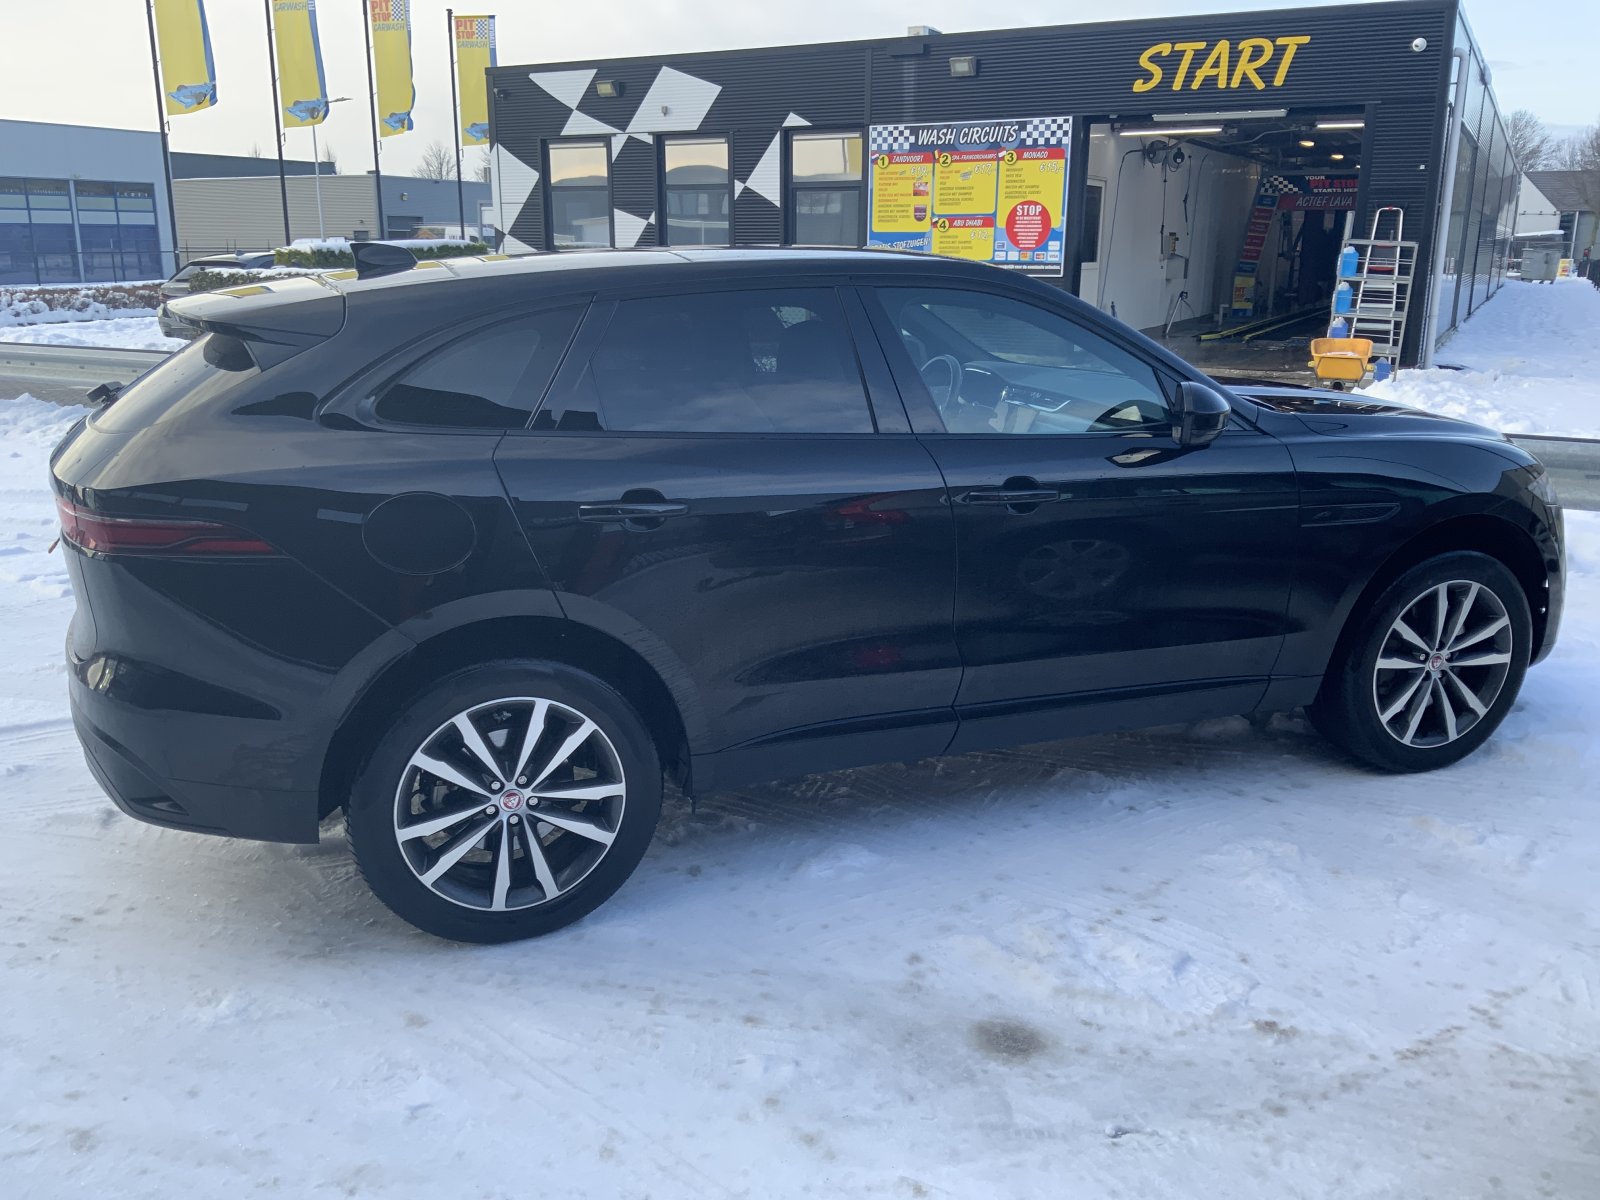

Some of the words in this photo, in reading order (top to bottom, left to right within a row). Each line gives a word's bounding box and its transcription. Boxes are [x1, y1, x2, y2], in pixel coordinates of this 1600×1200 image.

[274, 2, 308, 12] CARWASH
[371, 0, 391, 12] PIT
[372, 12, 391, 22] STOP
[373, 22, 406, 32] CARWASH
[455, 19, 475, 30] PIT
[456, 31, 476, 40] STOP
[457, 40, 488, 49] CARWASH
[1132, 36, 1311, 92] START
[917, 128, 955, 146] WASH
[959, 125, 1019, 144] CIRCUITS
[892, 155, 924, 163] ZANDVOORT
[1022, 151, 1049, 159] MONACO
[1296, 196, 1329, 207] ACTIEF
[1329, 195, 1353, 207] LAVA
[1016, 204, 1043, 216] STOP
[952, 219, 965, 227] ABU
